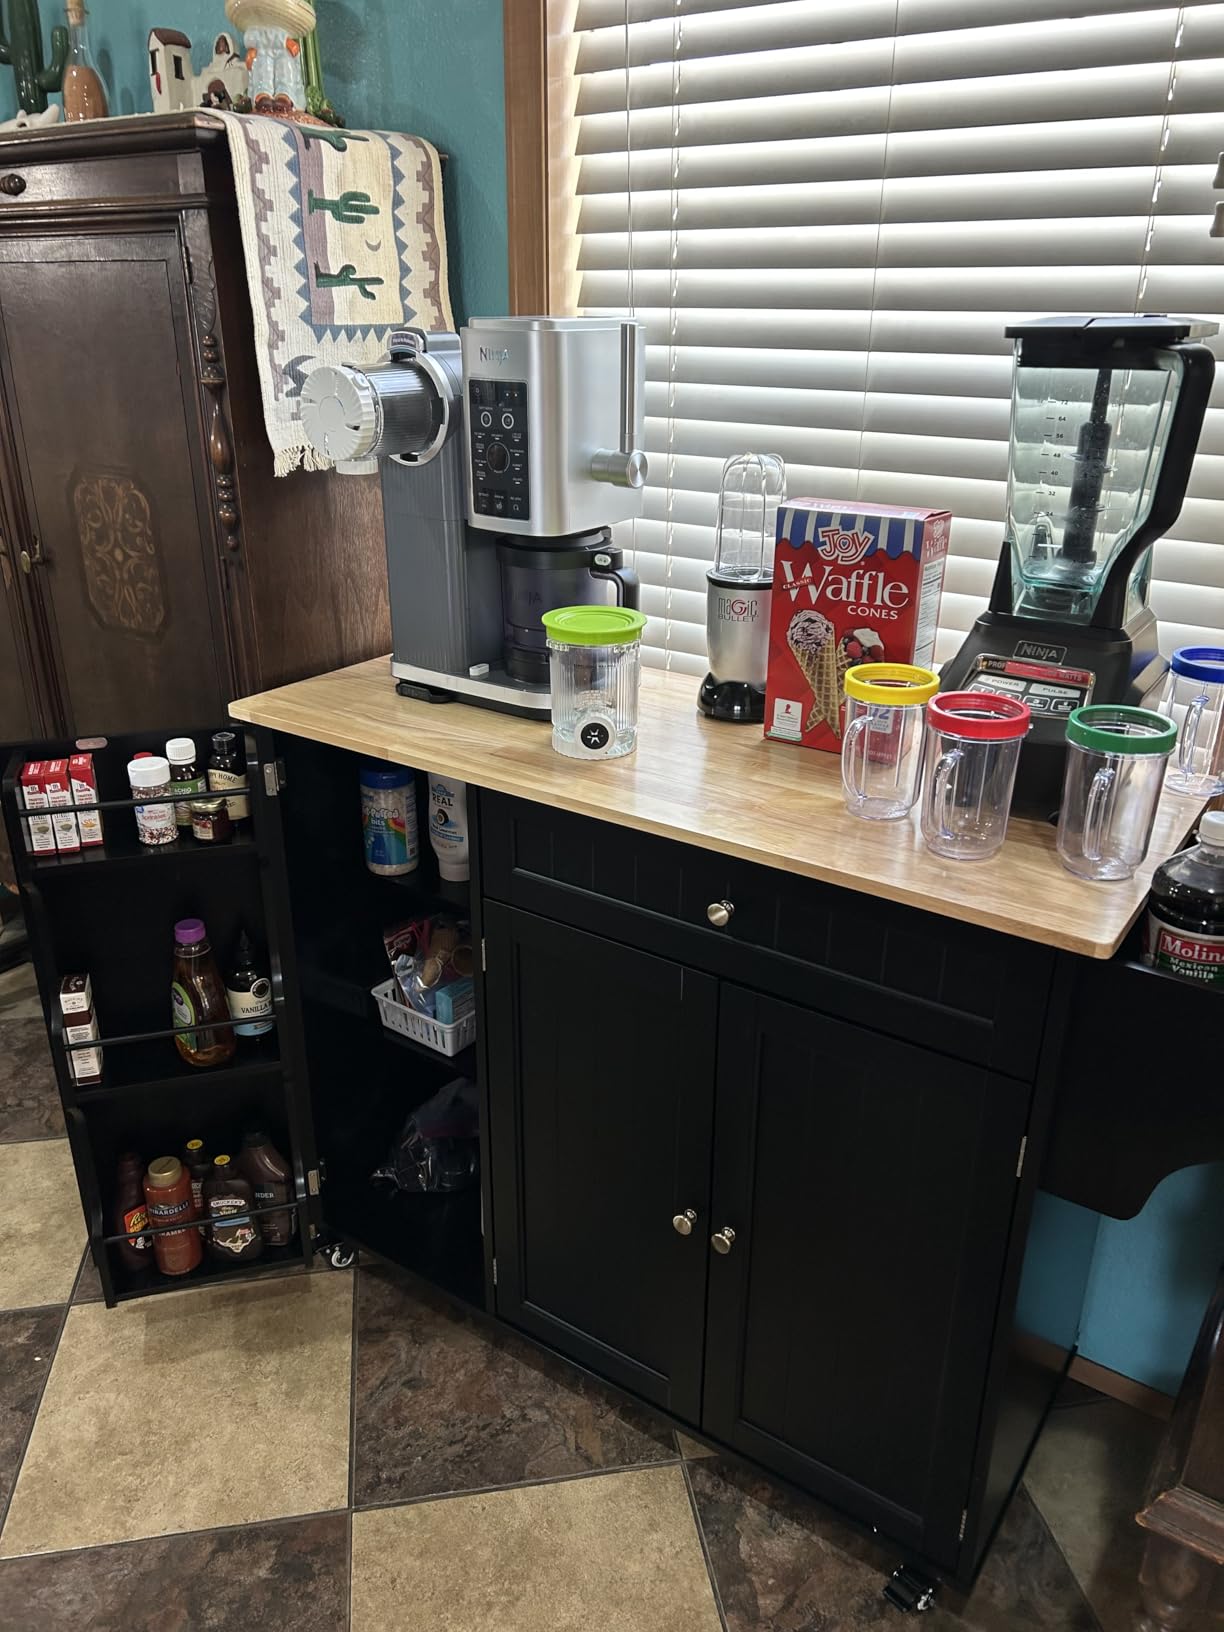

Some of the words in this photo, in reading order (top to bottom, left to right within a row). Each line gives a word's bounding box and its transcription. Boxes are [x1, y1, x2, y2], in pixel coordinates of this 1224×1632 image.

[780, 560, 909, 608] Waffle
[782, 577, 812, 590] CLASSIC
[847, 605, 899, 620] CONES
[1020, 643, 1058, 660] NINJA
[991, 678, 1020, 687] POWER
[1043, 686, 1069, 695] PULSE
[218, 772, 238, 784] HOME
[432, 793, 453, 807] REAL
[1169, 957, 1219, 972] Mexican
[1171, 965, 1215, 979] Vanilla
[241, 1003, 268, 1014] VANILLA
